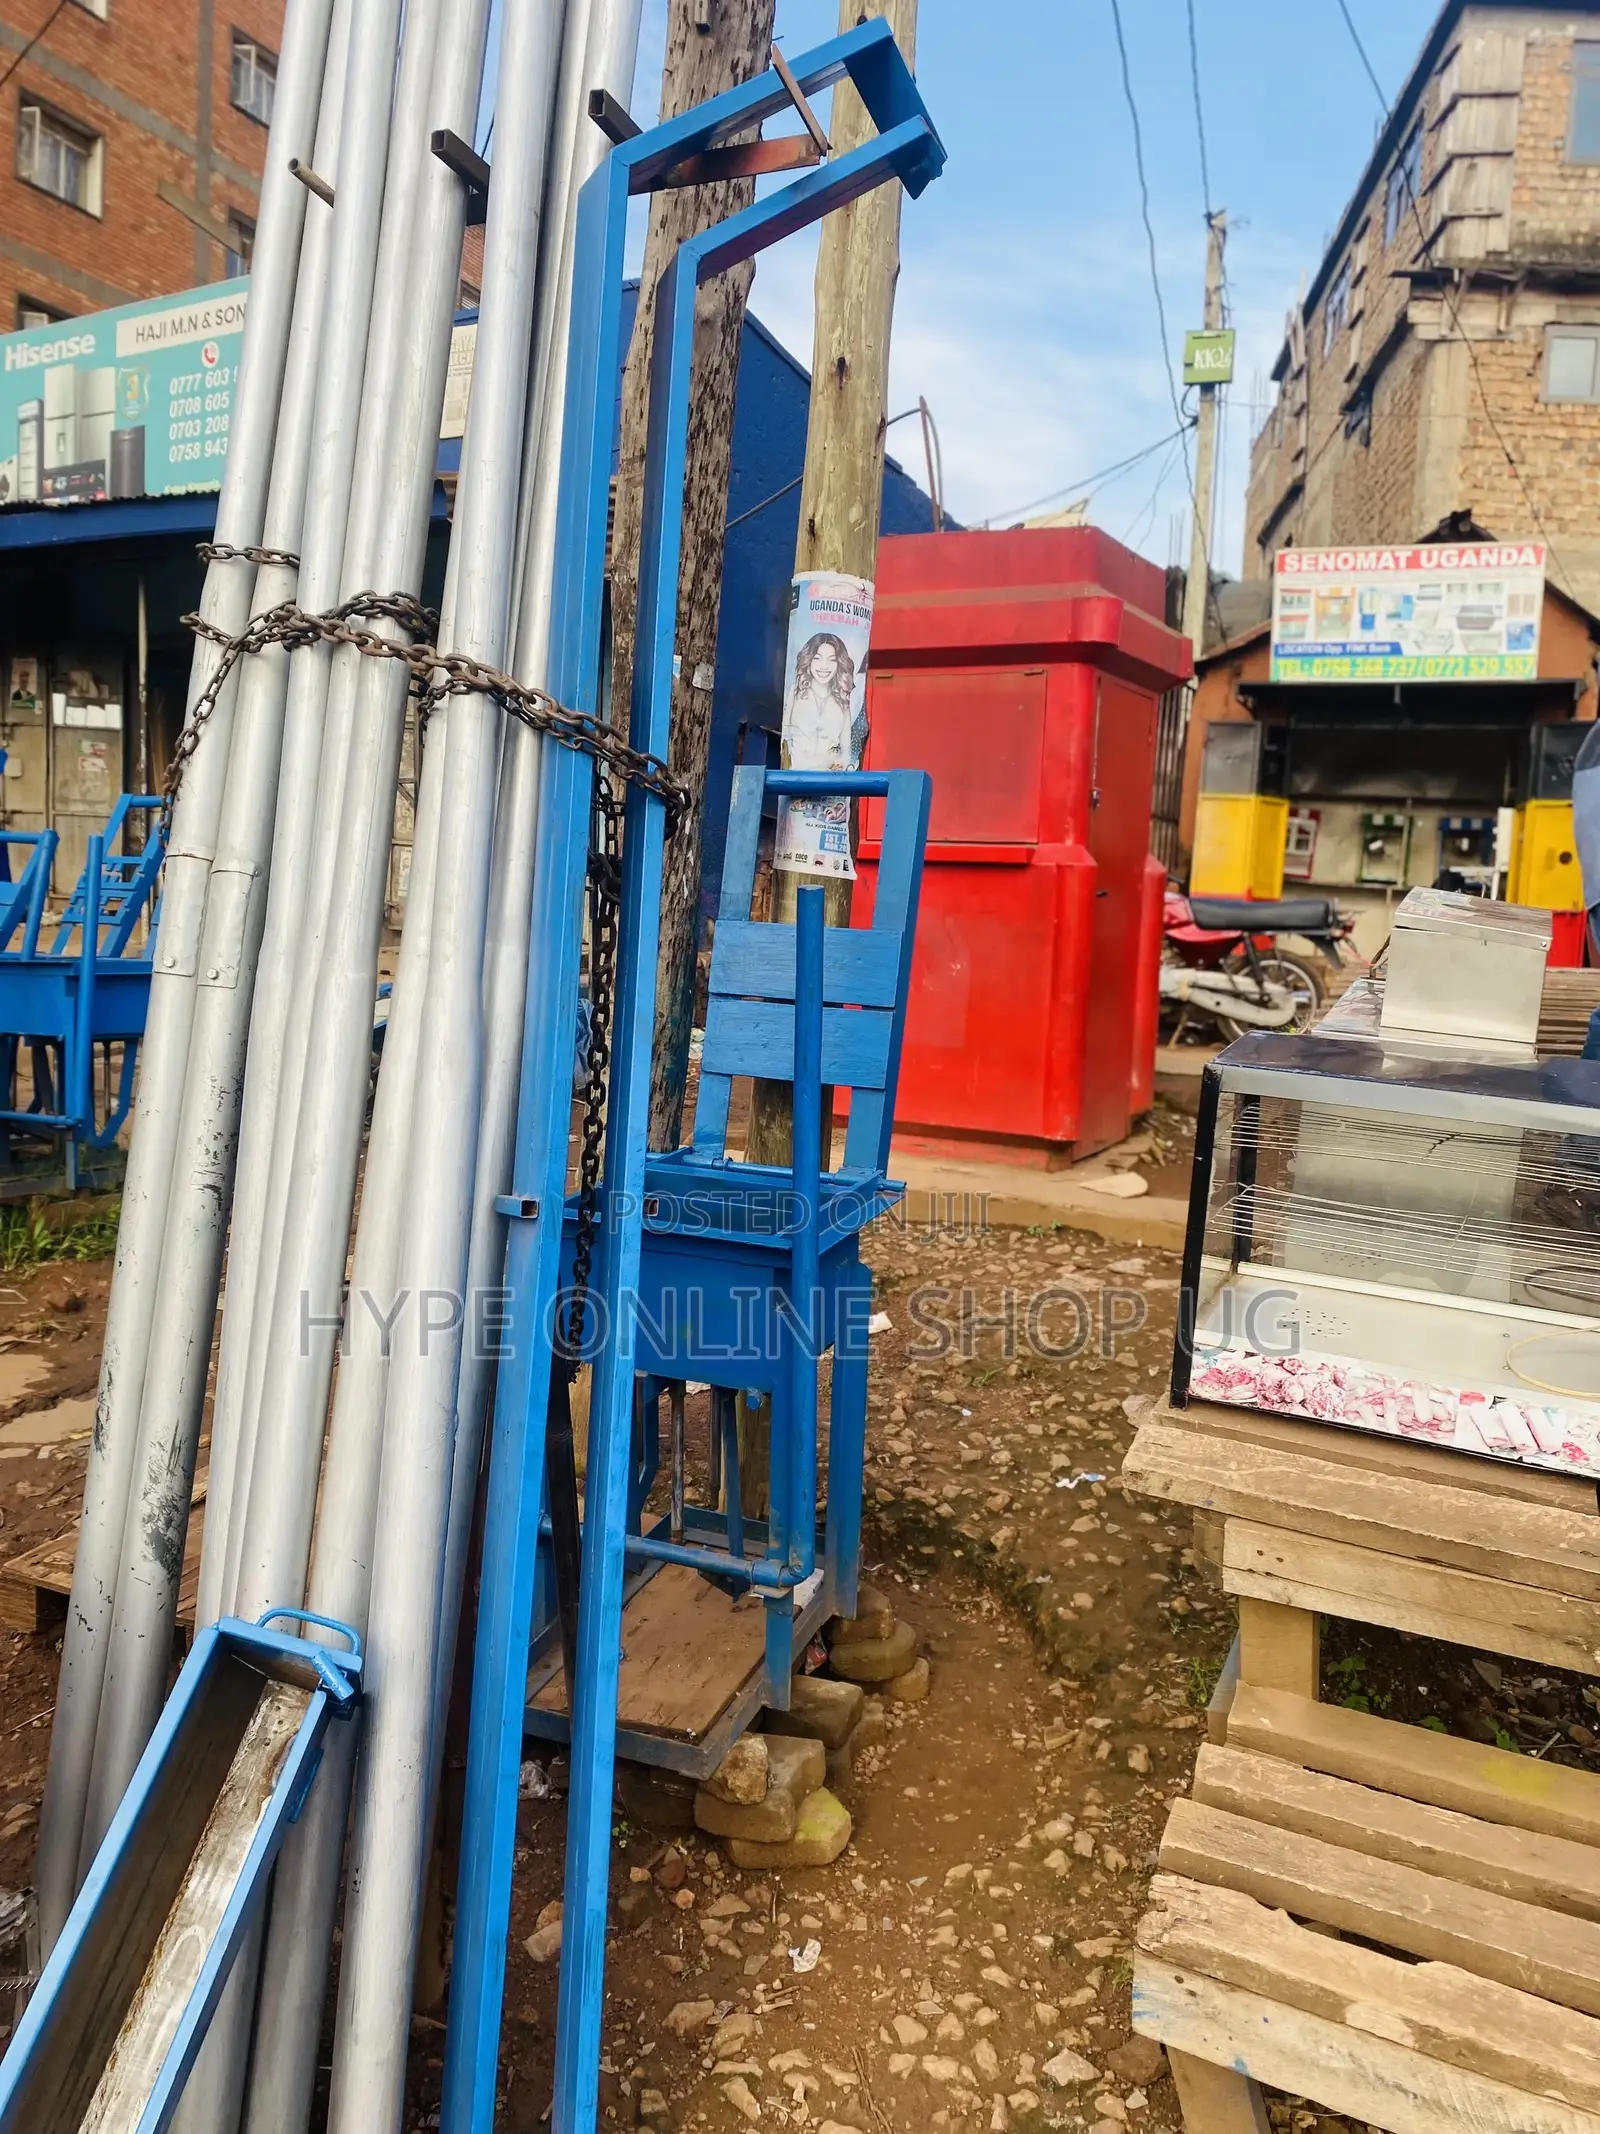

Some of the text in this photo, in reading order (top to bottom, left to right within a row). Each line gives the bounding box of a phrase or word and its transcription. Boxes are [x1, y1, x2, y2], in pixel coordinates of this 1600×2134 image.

[136, 321, 167, 344] HAJI
[170, 314, 198, 336] M.N
[201, 311, 212, 329] &
[5, 334, 96, 371] Hisense
[169, 373, 202, 395] 0777
[205, 367, 230, 388] 603
[169, 391, 230, 418] 0708 605
[169, 414, 229, 440] 0703 208
[169, 437, 229, 463] 0758 943
[1284, 546, 1537, 571] SENOMAT UGANDA
[810, 599, 852, 615] UGANDA'S
